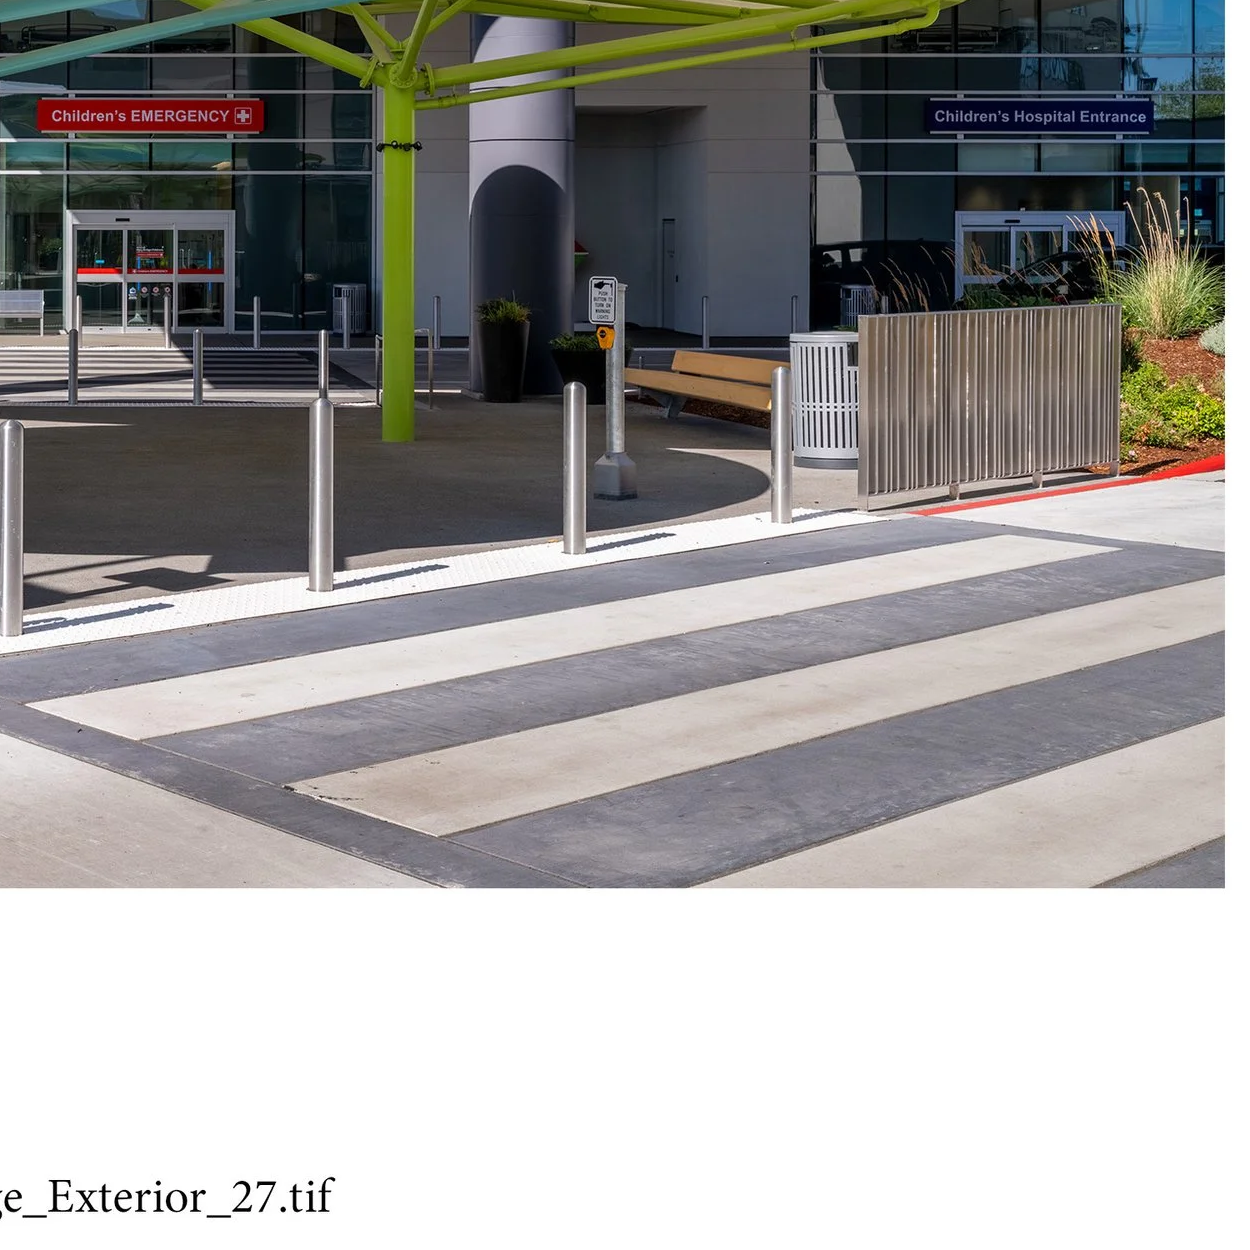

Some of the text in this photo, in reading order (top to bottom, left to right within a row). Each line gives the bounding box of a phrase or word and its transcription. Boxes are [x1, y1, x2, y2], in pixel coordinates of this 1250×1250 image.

[51, 109, 230, 123] Children's EMERGENCY
[934, 109, 1147, 126] Children's Hospital Entrance
